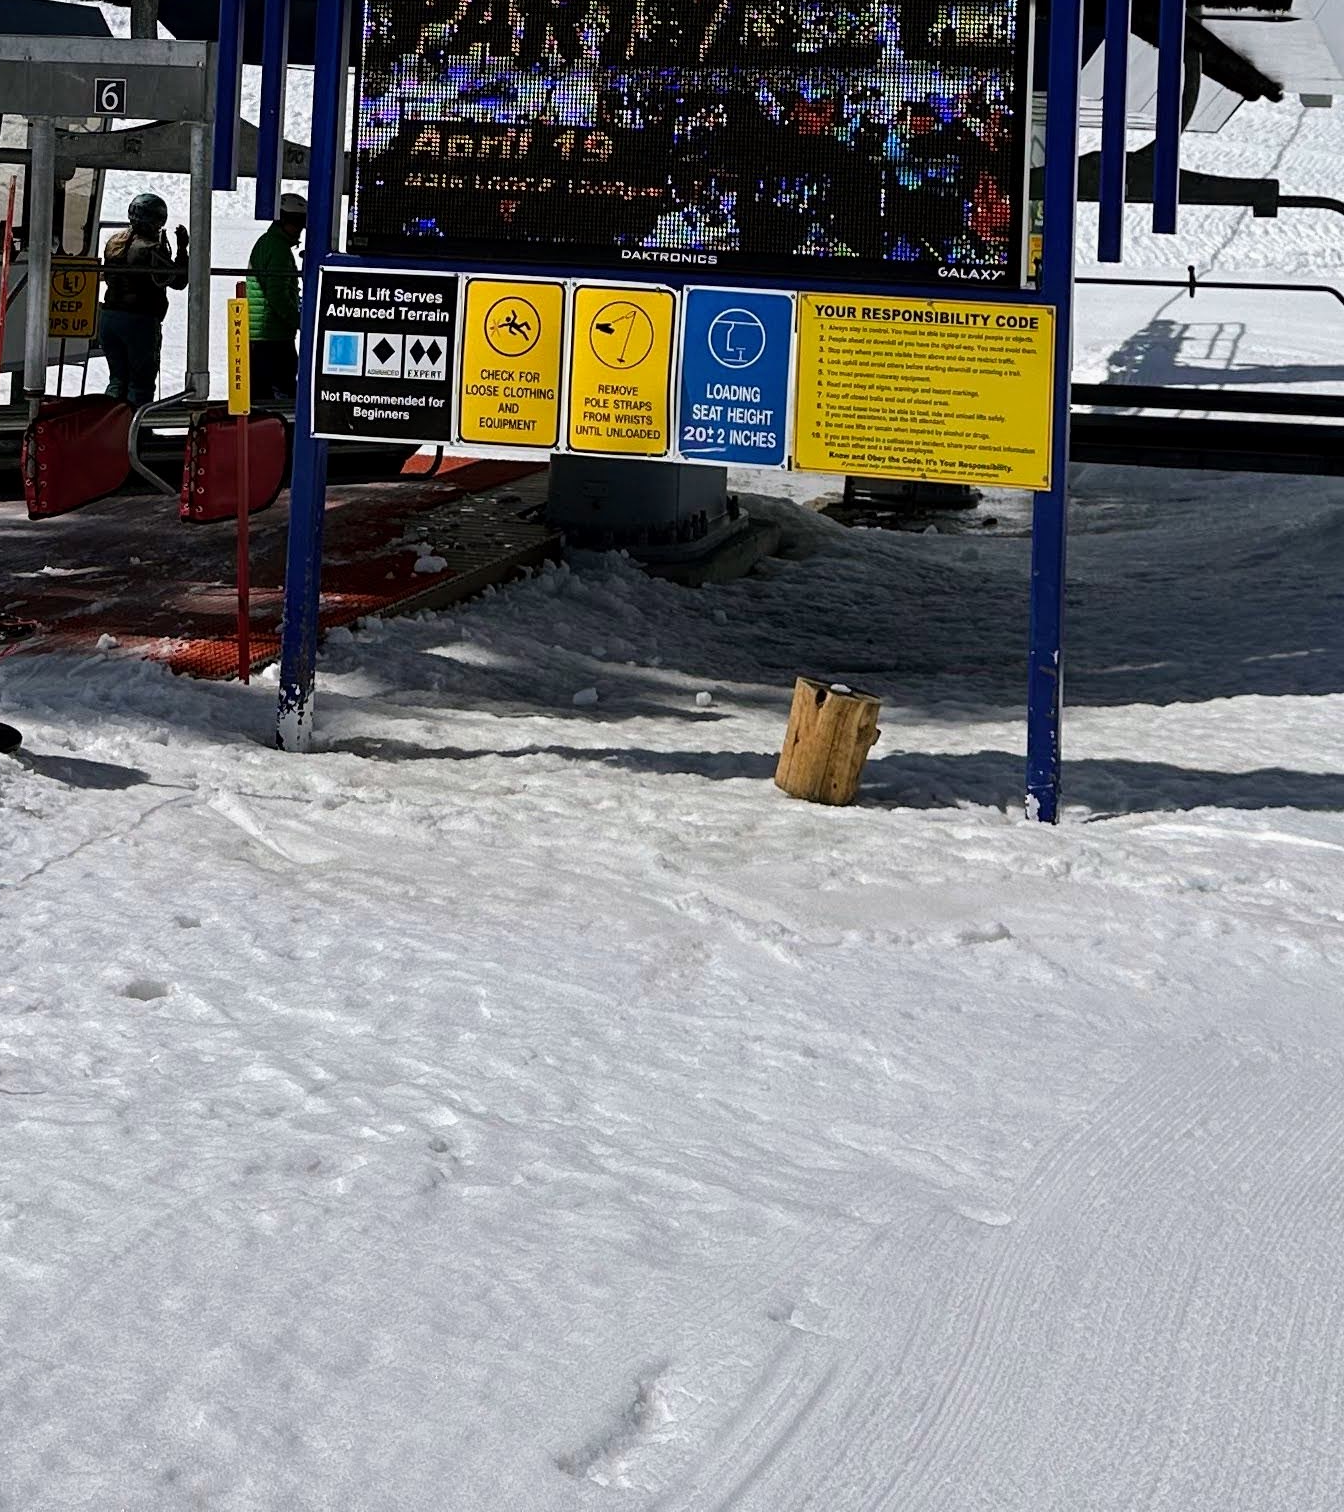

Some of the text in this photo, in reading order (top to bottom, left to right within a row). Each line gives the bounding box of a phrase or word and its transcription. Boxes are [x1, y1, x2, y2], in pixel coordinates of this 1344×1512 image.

[101, 82, 118, 111] 6
[411, 125, 533, 161] April
[621, 249, 718, 265] DAKTRONICS
[334, 285, 443, 304] This Lift Serves
[52, 300, 83, 312] KEEP
[326, 304, 450, 323] Advanced Terrain
[49, 318, 88, 331] IPS UP
[814, 304, 1038, 329] YOUR RESPONSIBILITY CODE
[233, 319, 242, 352] WAIT
[407, 369, 442, 379] EXPERT
[480, 369, 540, 383] CHECK FOR
[465, 384, 554, 400] LOOSE CLOTHING
[598, 384, 638, 396] REMOVE
[706, 383, 761, 402] LOADING
[321, 390, 445, 408] Not Recommended for
[584, 398, 652, 411] POLE STRAPS
[353, 407, 410, 421] Beginners
[498, 403, 519, 414] AND
[692, 404, 773, 426] SEAT HEIGHT
[479, 417, 537, 431] EQUIPMENT
[583, 412, 653, 426] FROM WRISTS
[576, 425, 661, 440] UNTIL UNLOADED
[729, 430, 777, 448] INCHES
